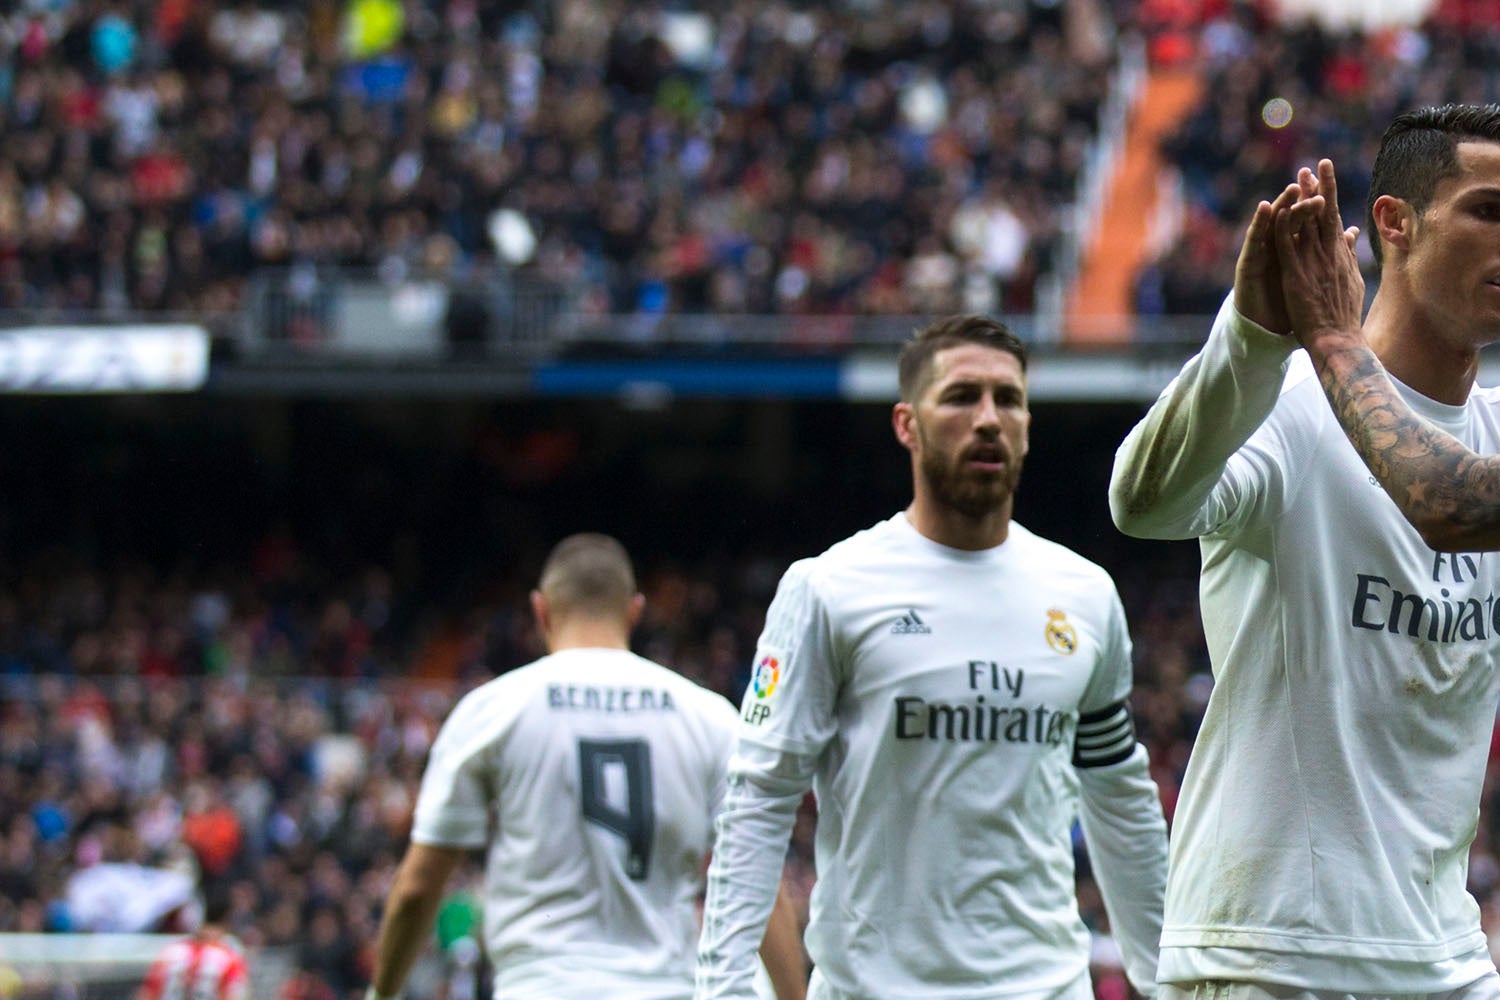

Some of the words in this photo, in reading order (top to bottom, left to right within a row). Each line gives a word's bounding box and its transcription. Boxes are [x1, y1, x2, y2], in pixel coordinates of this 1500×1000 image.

[968, 660, 1024, 698] Fly
[744, 701, 771, 725] LFP
[576, 737, 655, 881] 9
